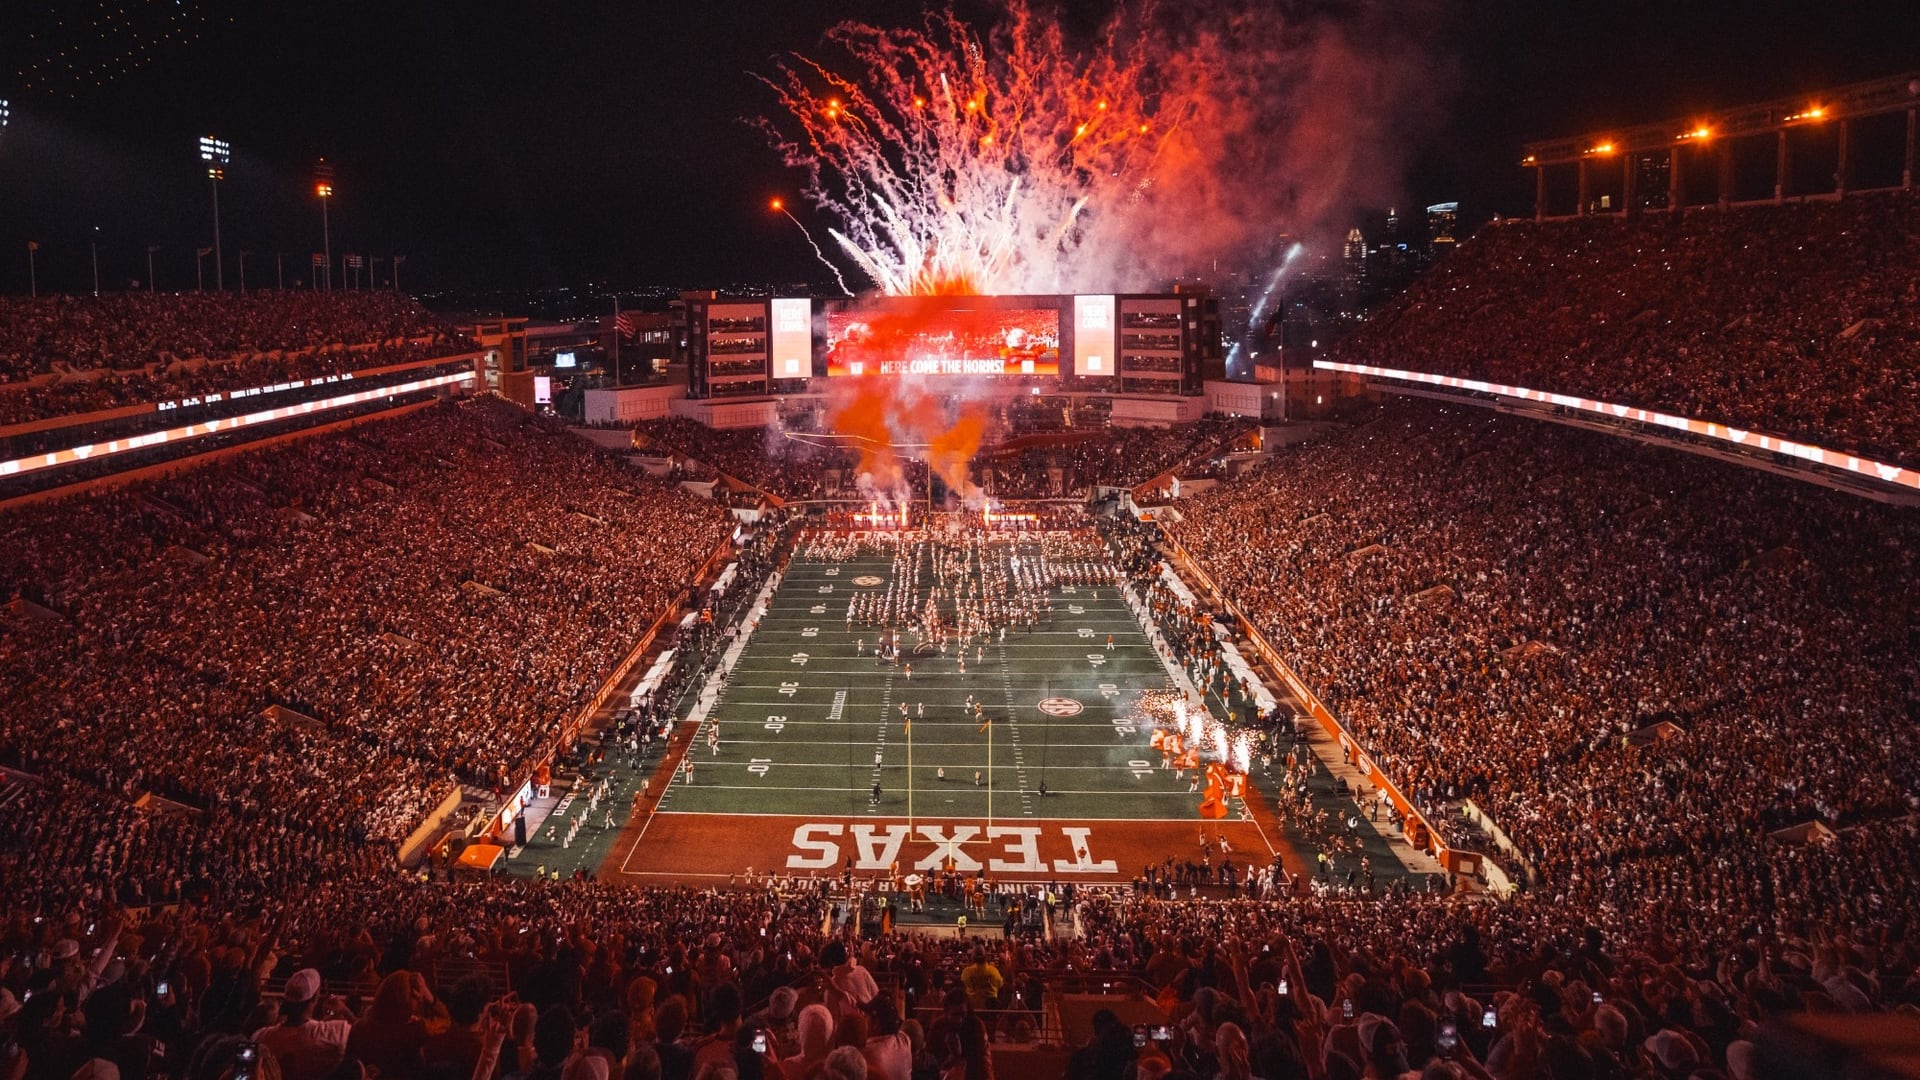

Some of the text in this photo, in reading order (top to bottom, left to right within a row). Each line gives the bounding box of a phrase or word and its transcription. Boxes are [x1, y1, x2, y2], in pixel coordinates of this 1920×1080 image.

[880, 360, 1005, 374] HERE COME THE HORNS!
[801, 627, 819, 637] 50
[1077, 628, 1095, 638] 50
[790, 652, 809, 663] 40
[1087, 654, 1106, 664] 40
[778, 682, 799, 694] 30
[1099, 683, 1120, 696] 30
[764, 715, 787, 730] 20
[1111, 718, 1137, 733] 20
[747, 758, 772, 772] 10
[1128, 759, 1154, 774] 10
[785, 823, 1118, 873] TEXAS
